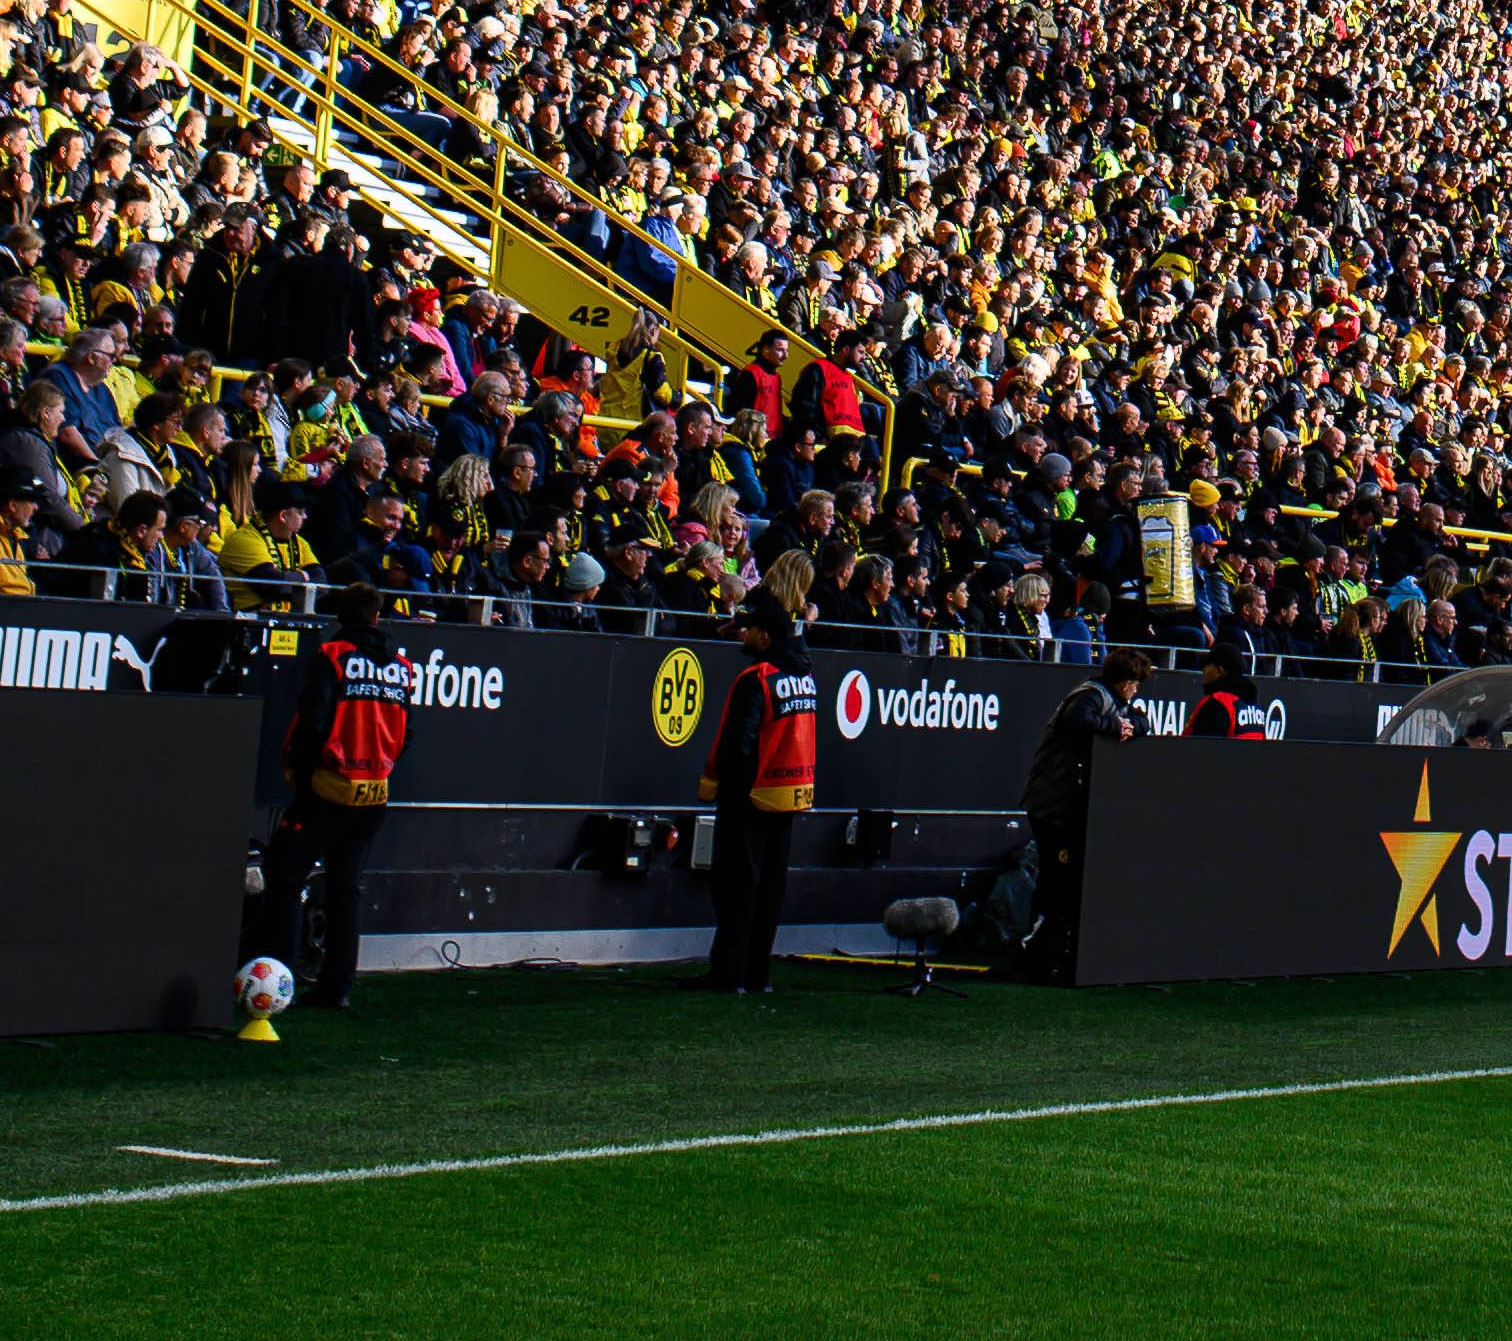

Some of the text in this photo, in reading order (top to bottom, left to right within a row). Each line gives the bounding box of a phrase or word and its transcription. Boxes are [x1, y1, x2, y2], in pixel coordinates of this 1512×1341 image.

[569, 306, 611, 328] 42
[396, 647, 504, 710] afone
[660, 659, 698, 715] BVB
[669, 715, 683, 734] 09
[878, 680, 1000, 733] vodafone
